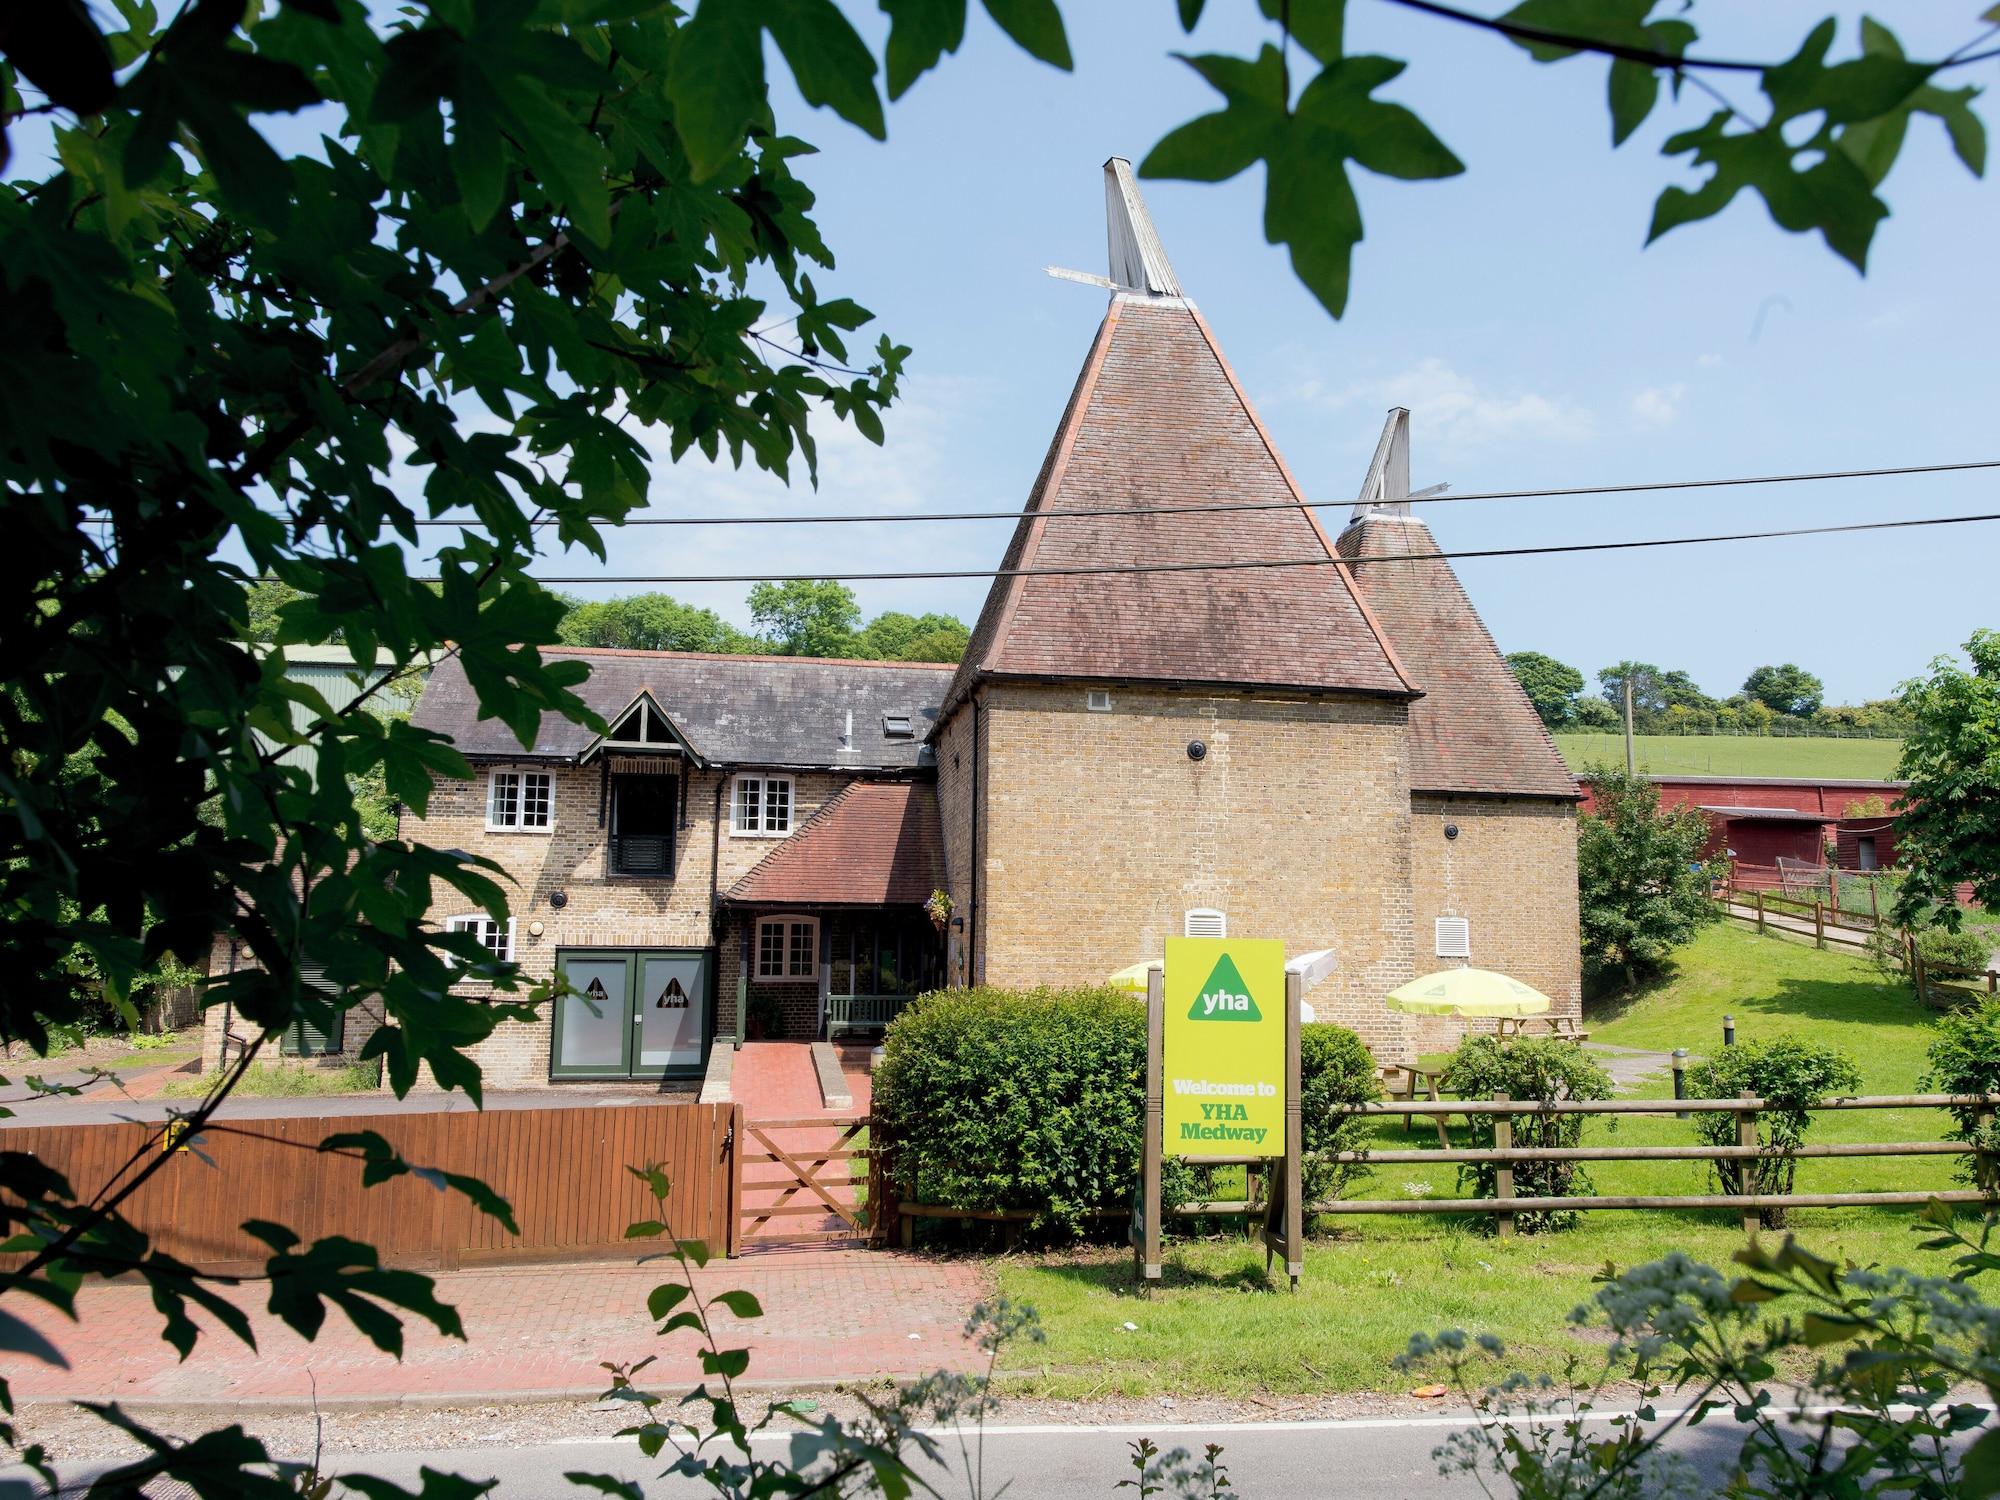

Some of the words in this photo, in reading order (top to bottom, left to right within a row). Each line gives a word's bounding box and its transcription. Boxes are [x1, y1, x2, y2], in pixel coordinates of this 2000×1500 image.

[662, 994, 684, 1004] yha
[1203, 989, 1248, 1015] yha
[1173, 1079, 1255, 1096] Welcome
[1258, 1081, 1276, 1096] to
[1200, 1103, 1248, 1120] YHA
[1180, 1123, 1267, 1144] Medway
